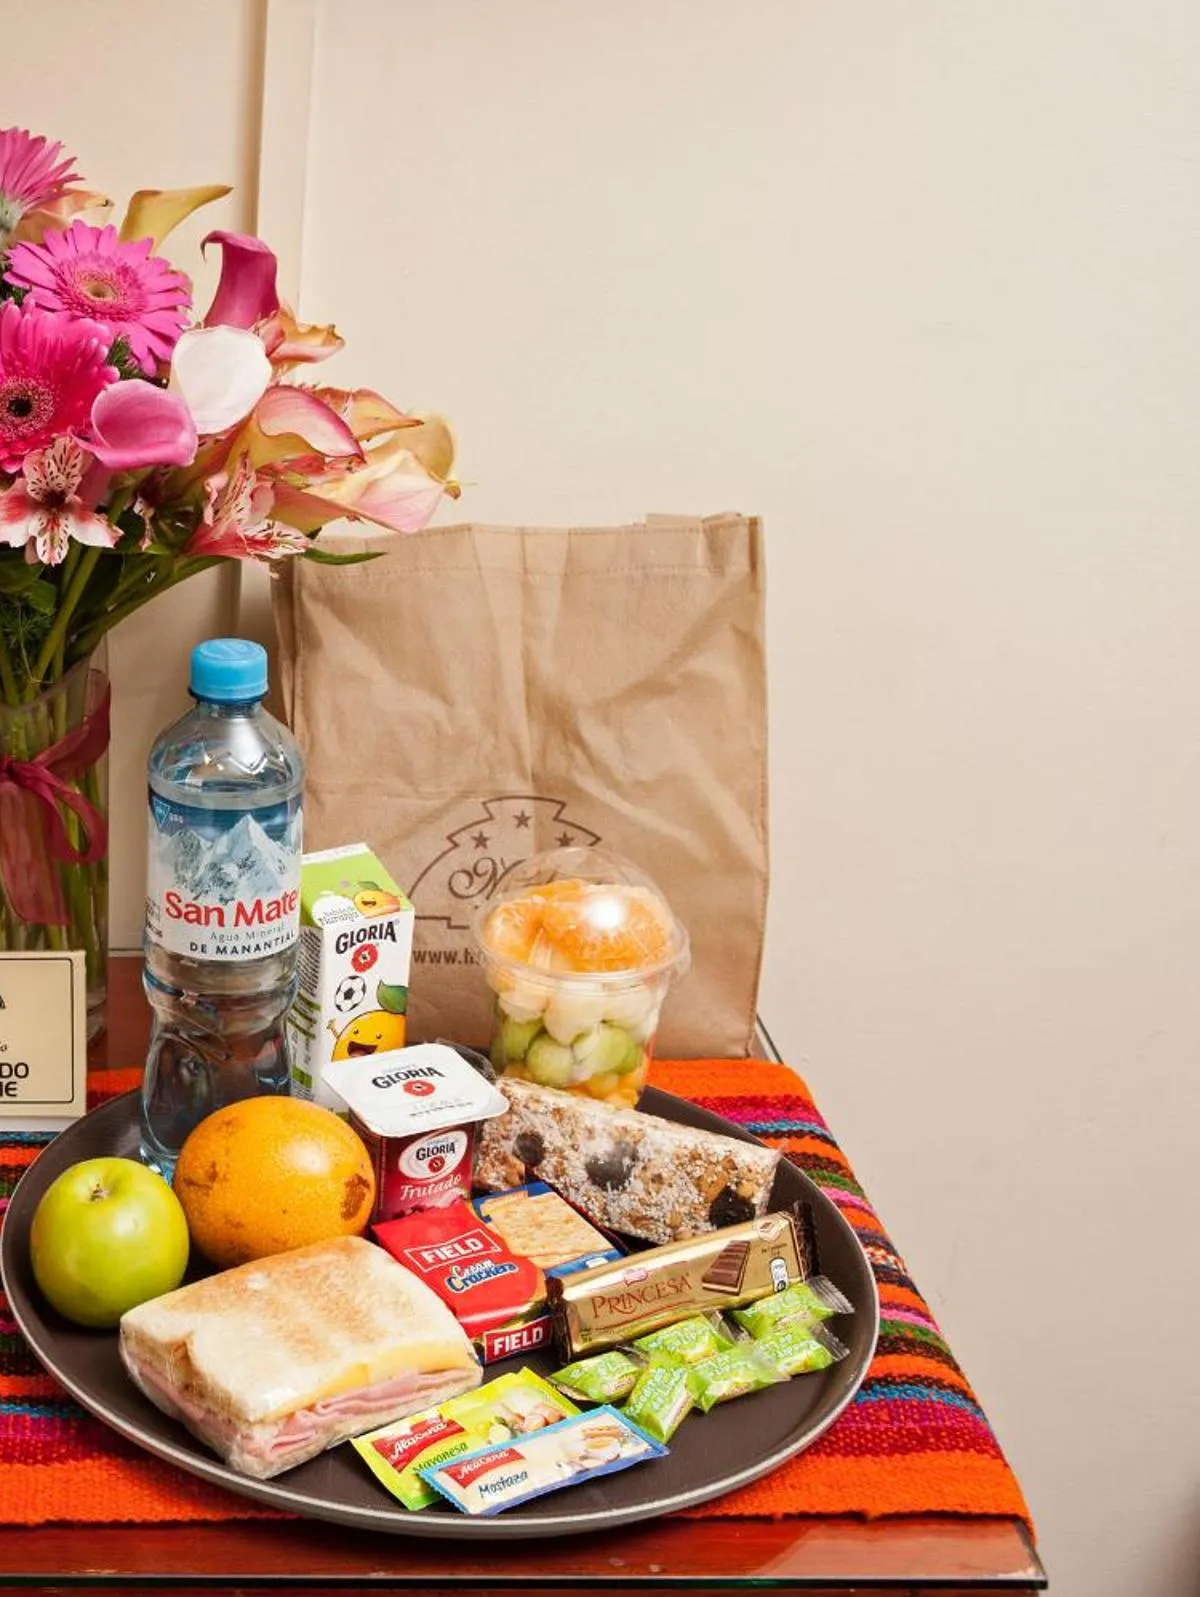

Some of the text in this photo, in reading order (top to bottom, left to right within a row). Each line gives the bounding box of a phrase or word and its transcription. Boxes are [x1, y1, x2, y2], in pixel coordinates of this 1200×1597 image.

[164, 891, 225, 928] San
[233, 889, 299, 928] Mate
[189, 931, 295, 956] DE MANANTIAL
[335, 921, 397, 955] GLORIA
[371, 1066, 446, 1090] GLORIA
[415, 1142, 456, 1162] GLORIA
[400, 1173, 463, 1201] Frutado
[421, 1236, 484, 1264] FIELD
[591, 1274, 693, 1318] PRINCESA
[493, 1326, 544, 1356] FIELD
[478, 1470, 529, 1499] Mostaza
